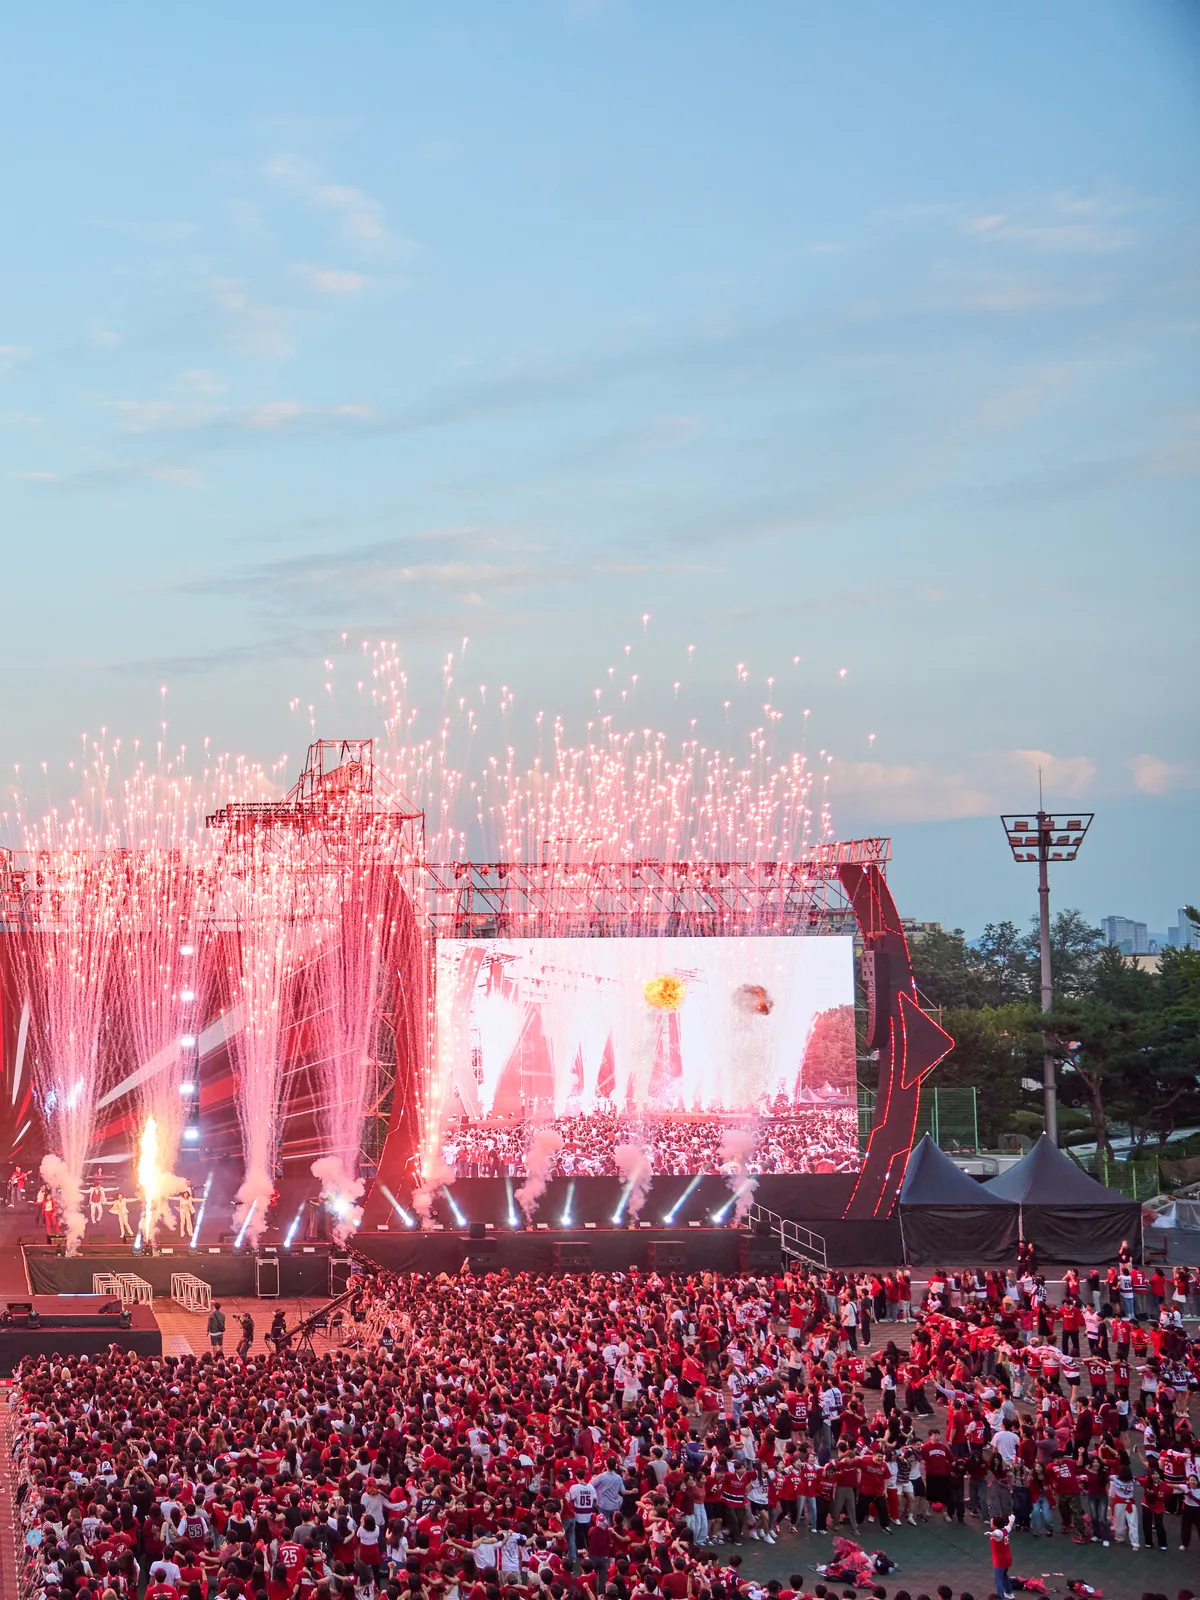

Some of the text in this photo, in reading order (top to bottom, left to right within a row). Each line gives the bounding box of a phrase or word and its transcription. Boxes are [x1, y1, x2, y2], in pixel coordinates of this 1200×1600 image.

[855, 1364, 863, 1373] 55
[1090, 1366, 1104, 1375] 66
[796, 1406, 806, 1416] 25
[580, 1496, 591, 1506] 05
[188, 1523, 202, 1538] 55
[282, 1550, 297, 1563] 25
[363, 1586, 370, 1597] 4
